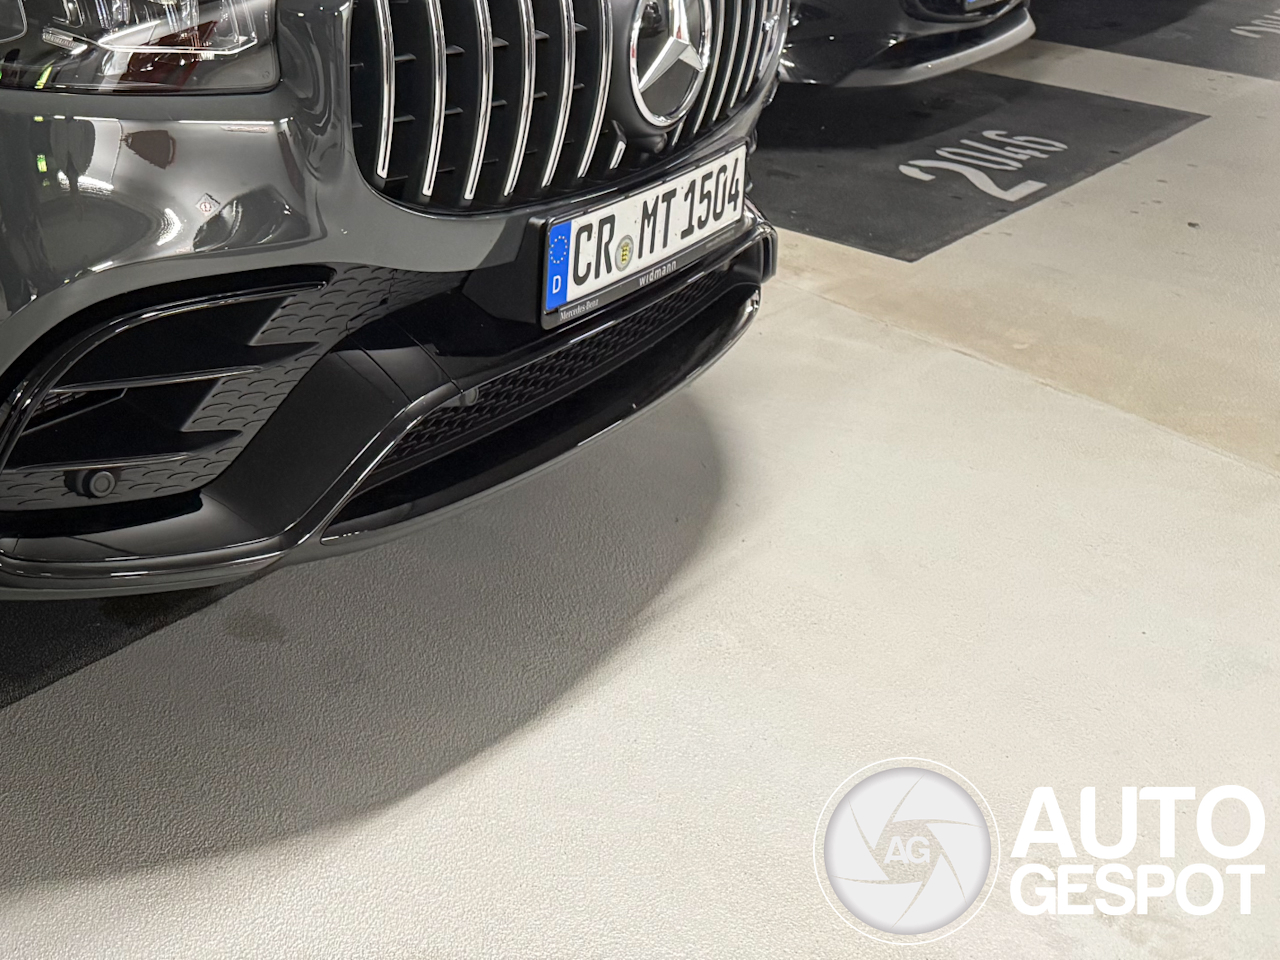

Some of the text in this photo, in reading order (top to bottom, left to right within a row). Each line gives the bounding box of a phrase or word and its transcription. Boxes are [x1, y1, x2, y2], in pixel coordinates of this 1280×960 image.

[898, 130, 1069, 202] 2046
[572, 157, 740, 286] CR MT 1504
[551, 274, 562, 294] D
[559, 298, 600, 321] Mercedes-Benz
